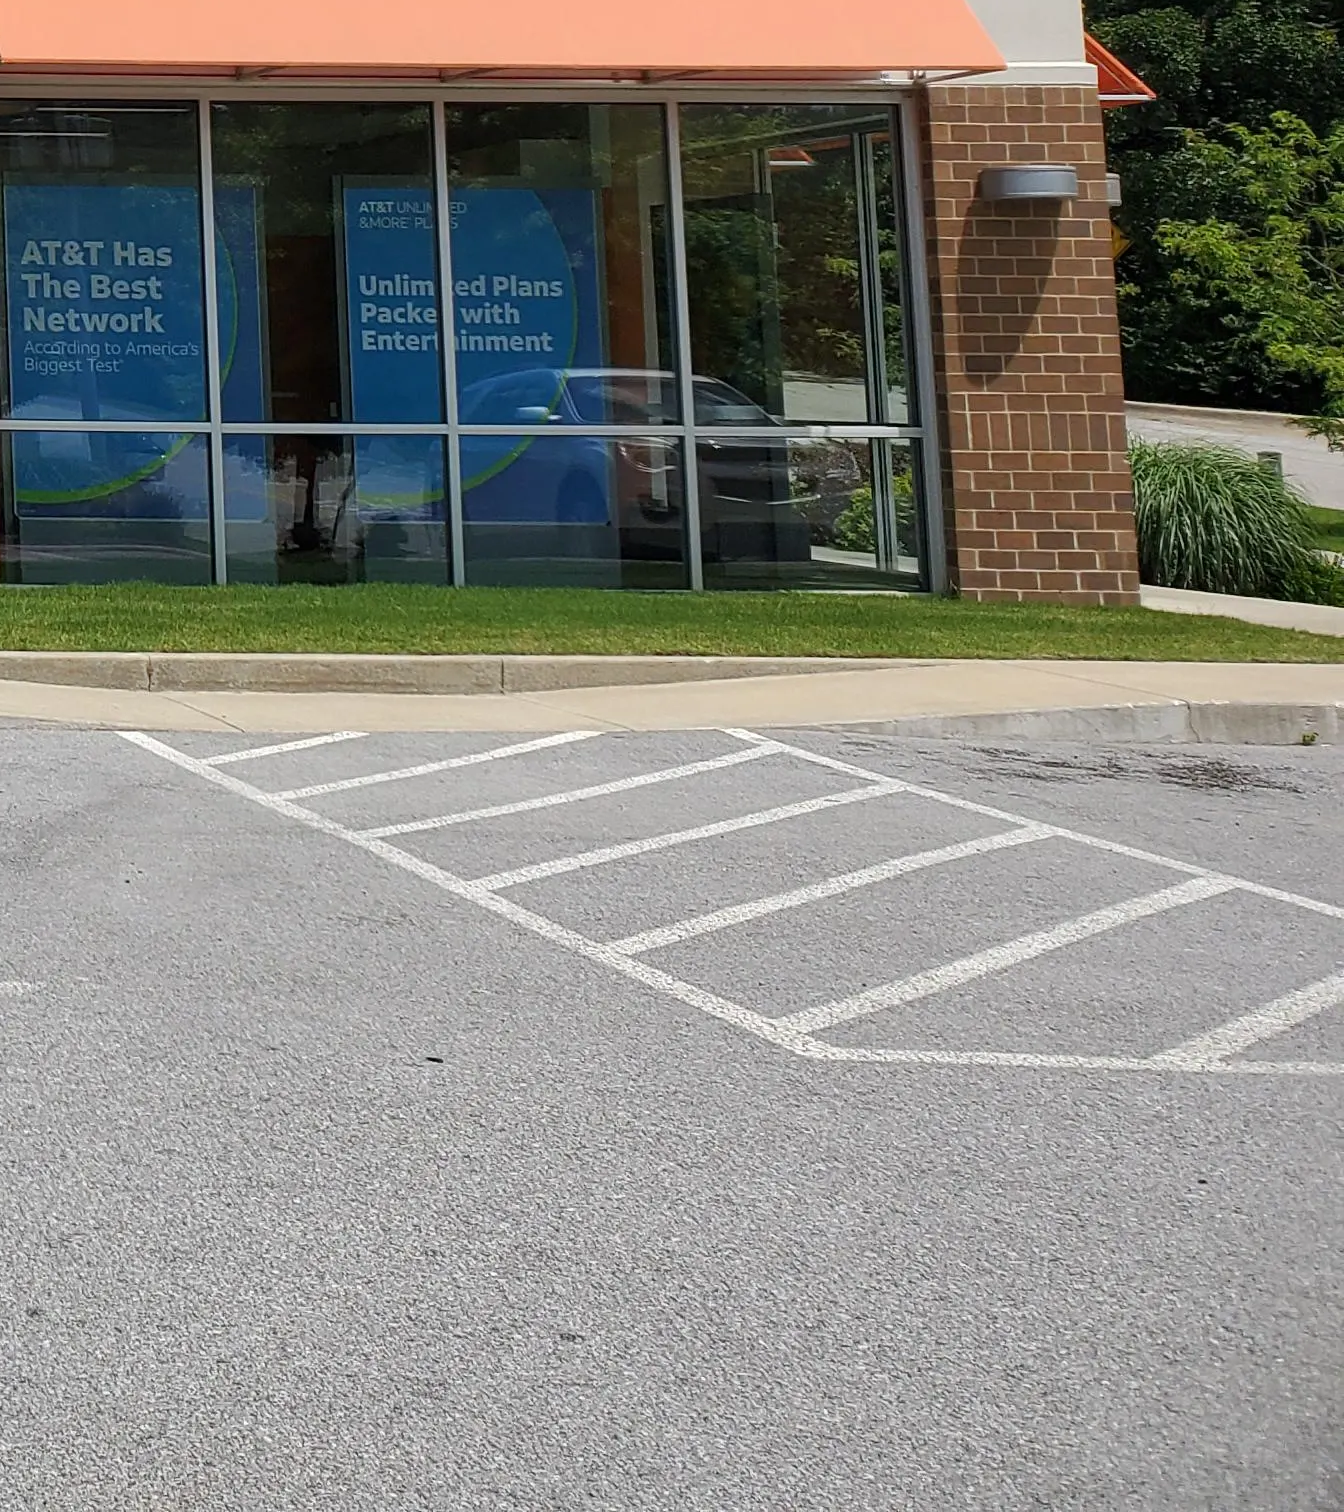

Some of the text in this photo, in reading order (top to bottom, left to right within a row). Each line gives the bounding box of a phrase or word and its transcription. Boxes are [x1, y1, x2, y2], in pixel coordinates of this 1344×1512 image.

[359, 201, 468, 214] AT&T UNLIED
[414, 217, 459, 230] PLS
[21, 240, 173, 267] AT&T Has
[21, 272, 163, 300] The Best
[359, 274, 564, 297] Unlimed Plans
[23, 306, 166, 333] Network
[361, 302, 521, 325] Packe with
[24, 340, 199, 358] According to America's
[362, 328, 555, 353] Entertinment
[24, 357, 83, 375] Biggest
